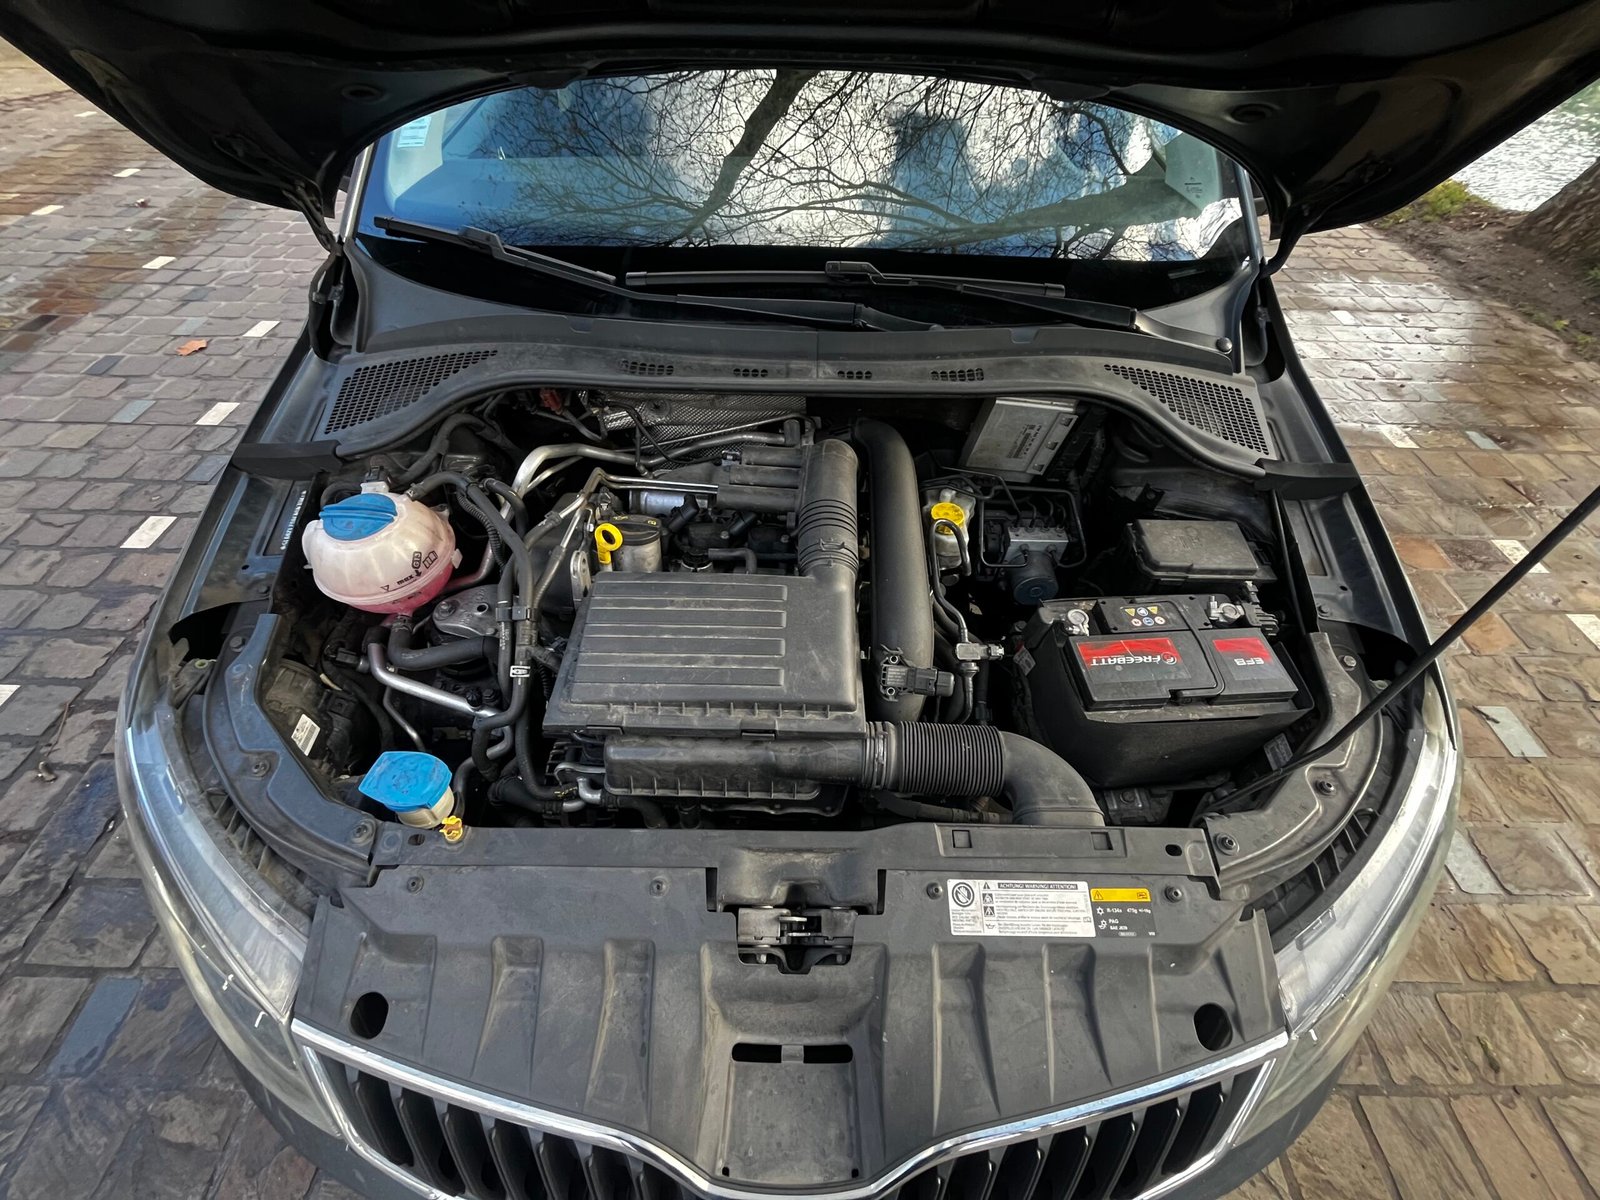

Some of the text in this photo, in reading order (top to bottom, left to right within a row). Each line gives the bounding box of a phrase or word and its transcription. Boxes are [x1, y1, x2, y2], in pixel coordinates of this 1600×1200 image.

[397, 574, 413, 585] max
[1090, 655, 1161, 666] FREEBATT
[1233, 657, 1265, 666] EFB
